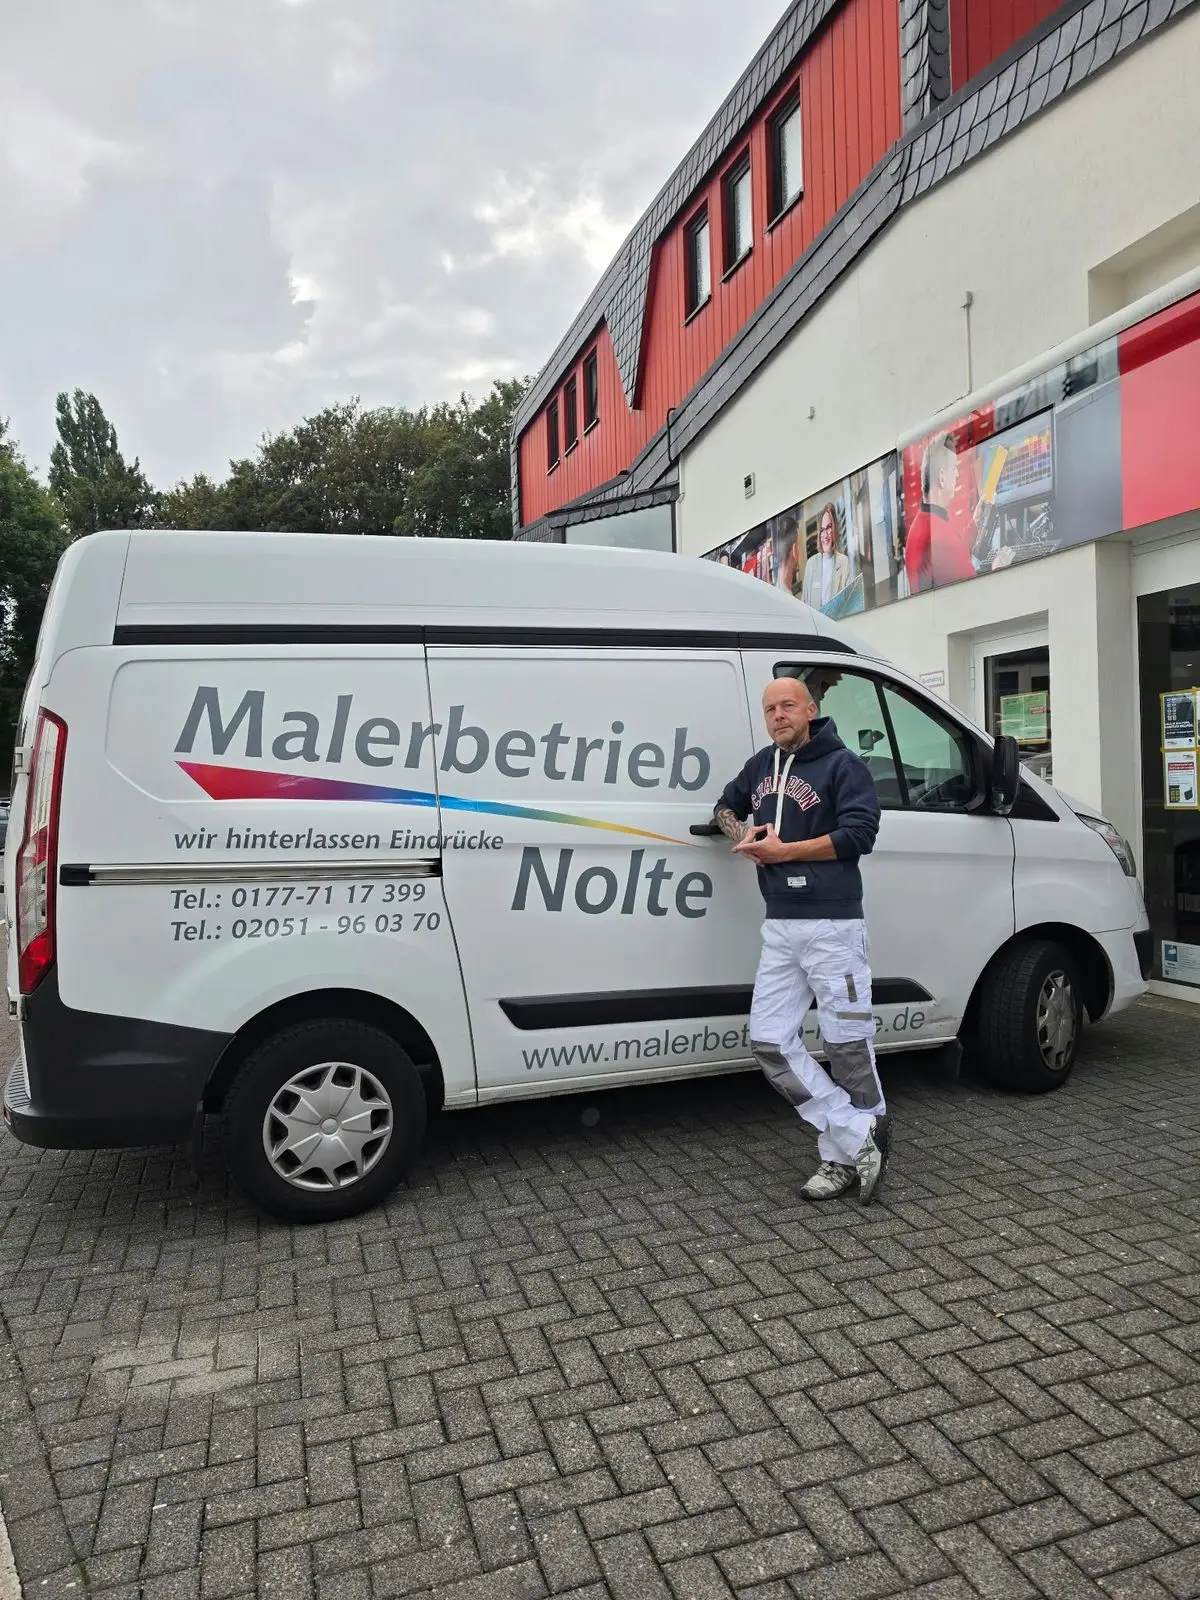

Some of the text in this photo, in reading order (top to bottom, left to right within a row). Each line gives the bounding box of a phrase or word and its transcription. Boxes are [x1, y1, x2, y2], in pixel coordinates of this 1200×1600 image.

[174, 685, 711, 791] Malerbetrieb
[174, 827, 504, 850] wir hinterlassen Eindrücke
[170, 883, 427, 909] Tel.: 0177-71 17 399
[511, 846, 713, 919] Nolte
[170, 920, 222, 941] Tel.:
[231, 918, 308, 939] 02051
[337, 915, 366, 935] 96
[374, 913, 402, 933] 03
[412, 911, 441, 932] 70
